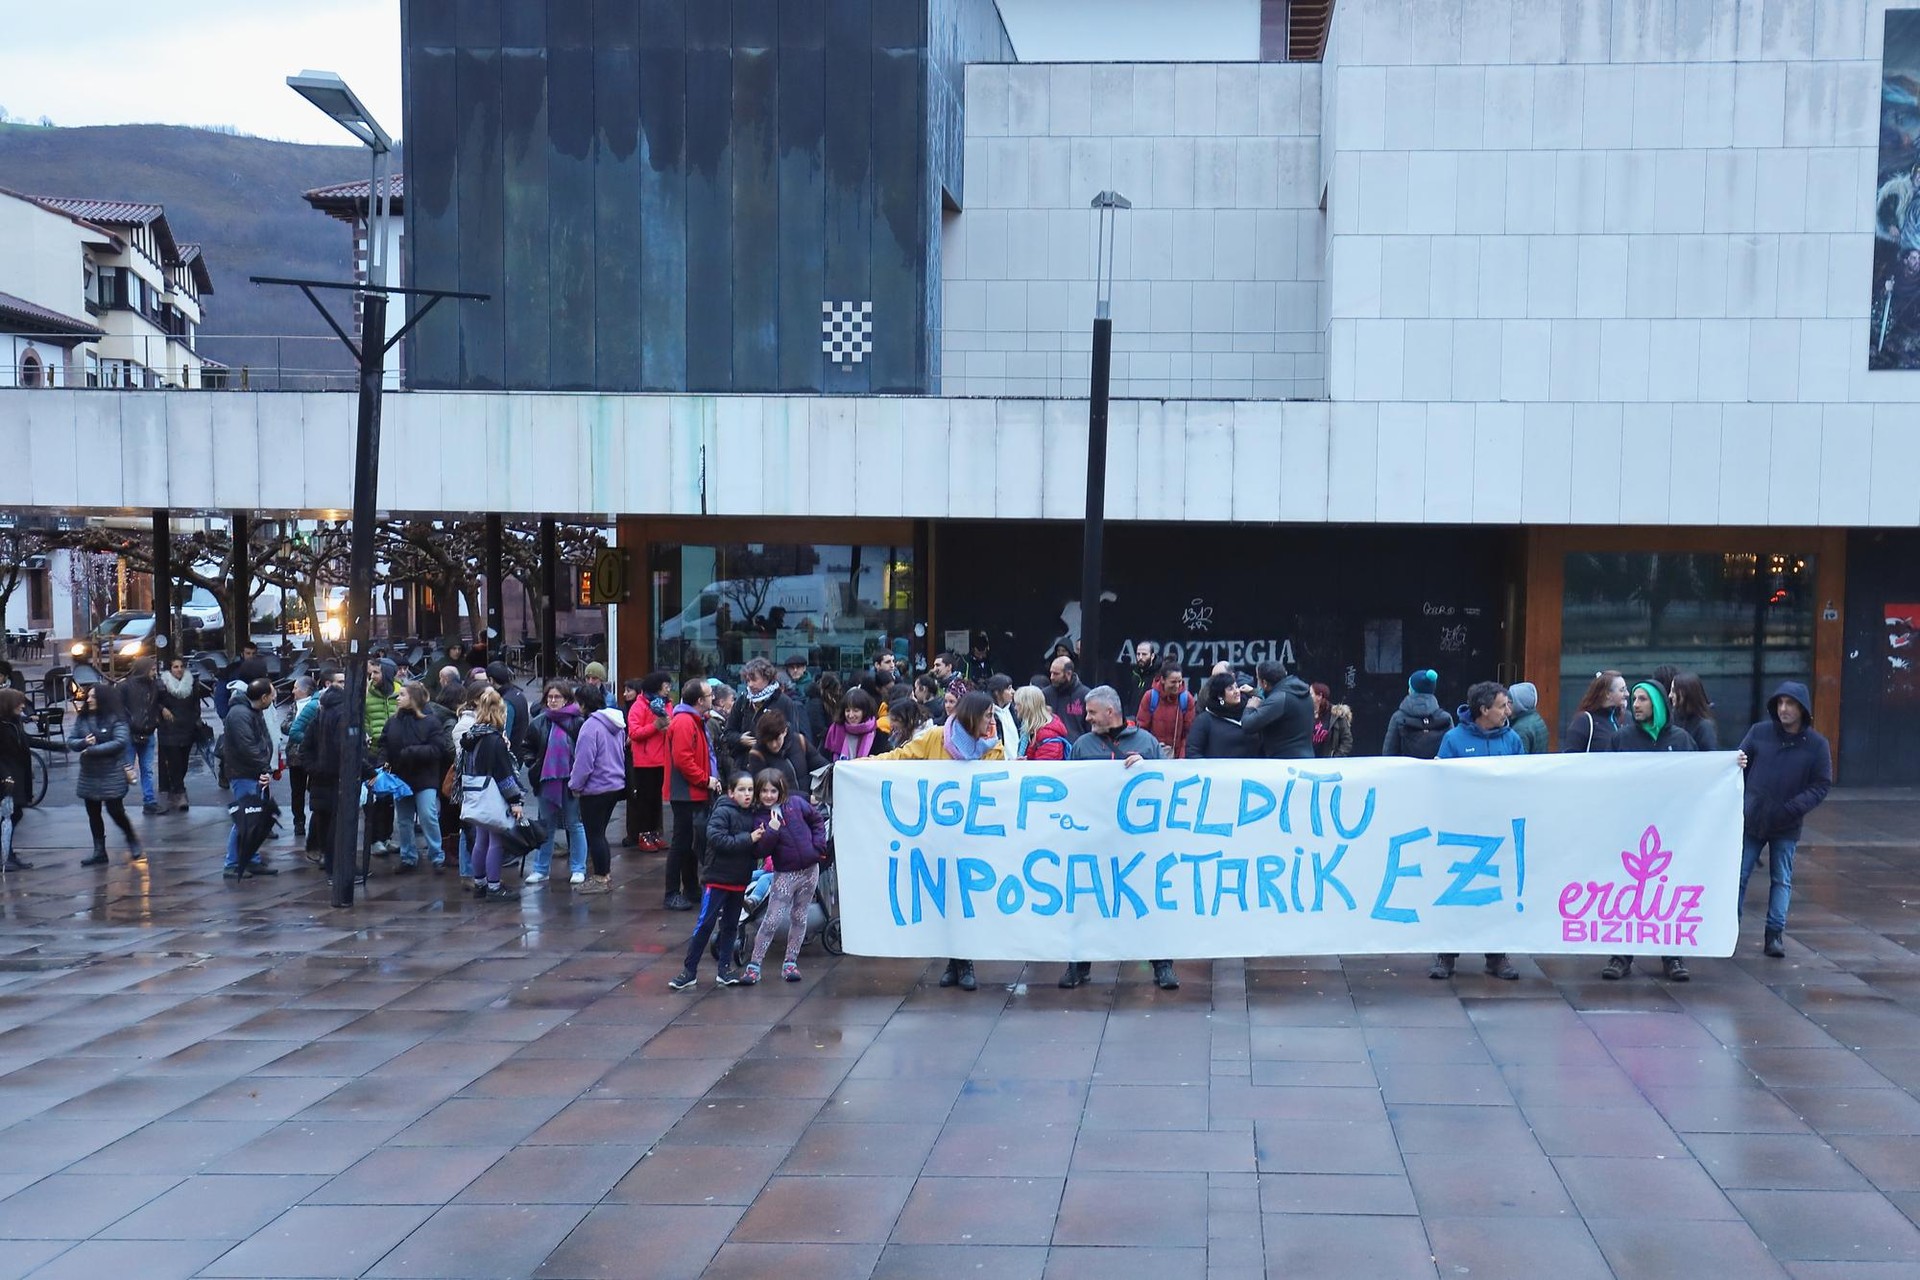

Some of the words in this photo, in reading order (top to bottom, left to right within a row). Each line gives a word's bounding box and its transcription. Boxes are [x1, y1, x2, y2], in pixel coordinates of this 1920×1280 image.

[1181, 606, 1214, 624] 1312
[1115, 638, 1296, 667] AOZTEGIA
[1116, 766, 1377, 841] GELDiTU
[1369, 817, 1527, 924] EZ!
[1558, 874, 1705, 923] erdiz
[1561, 919, 1698, 946] BIZIRIK
